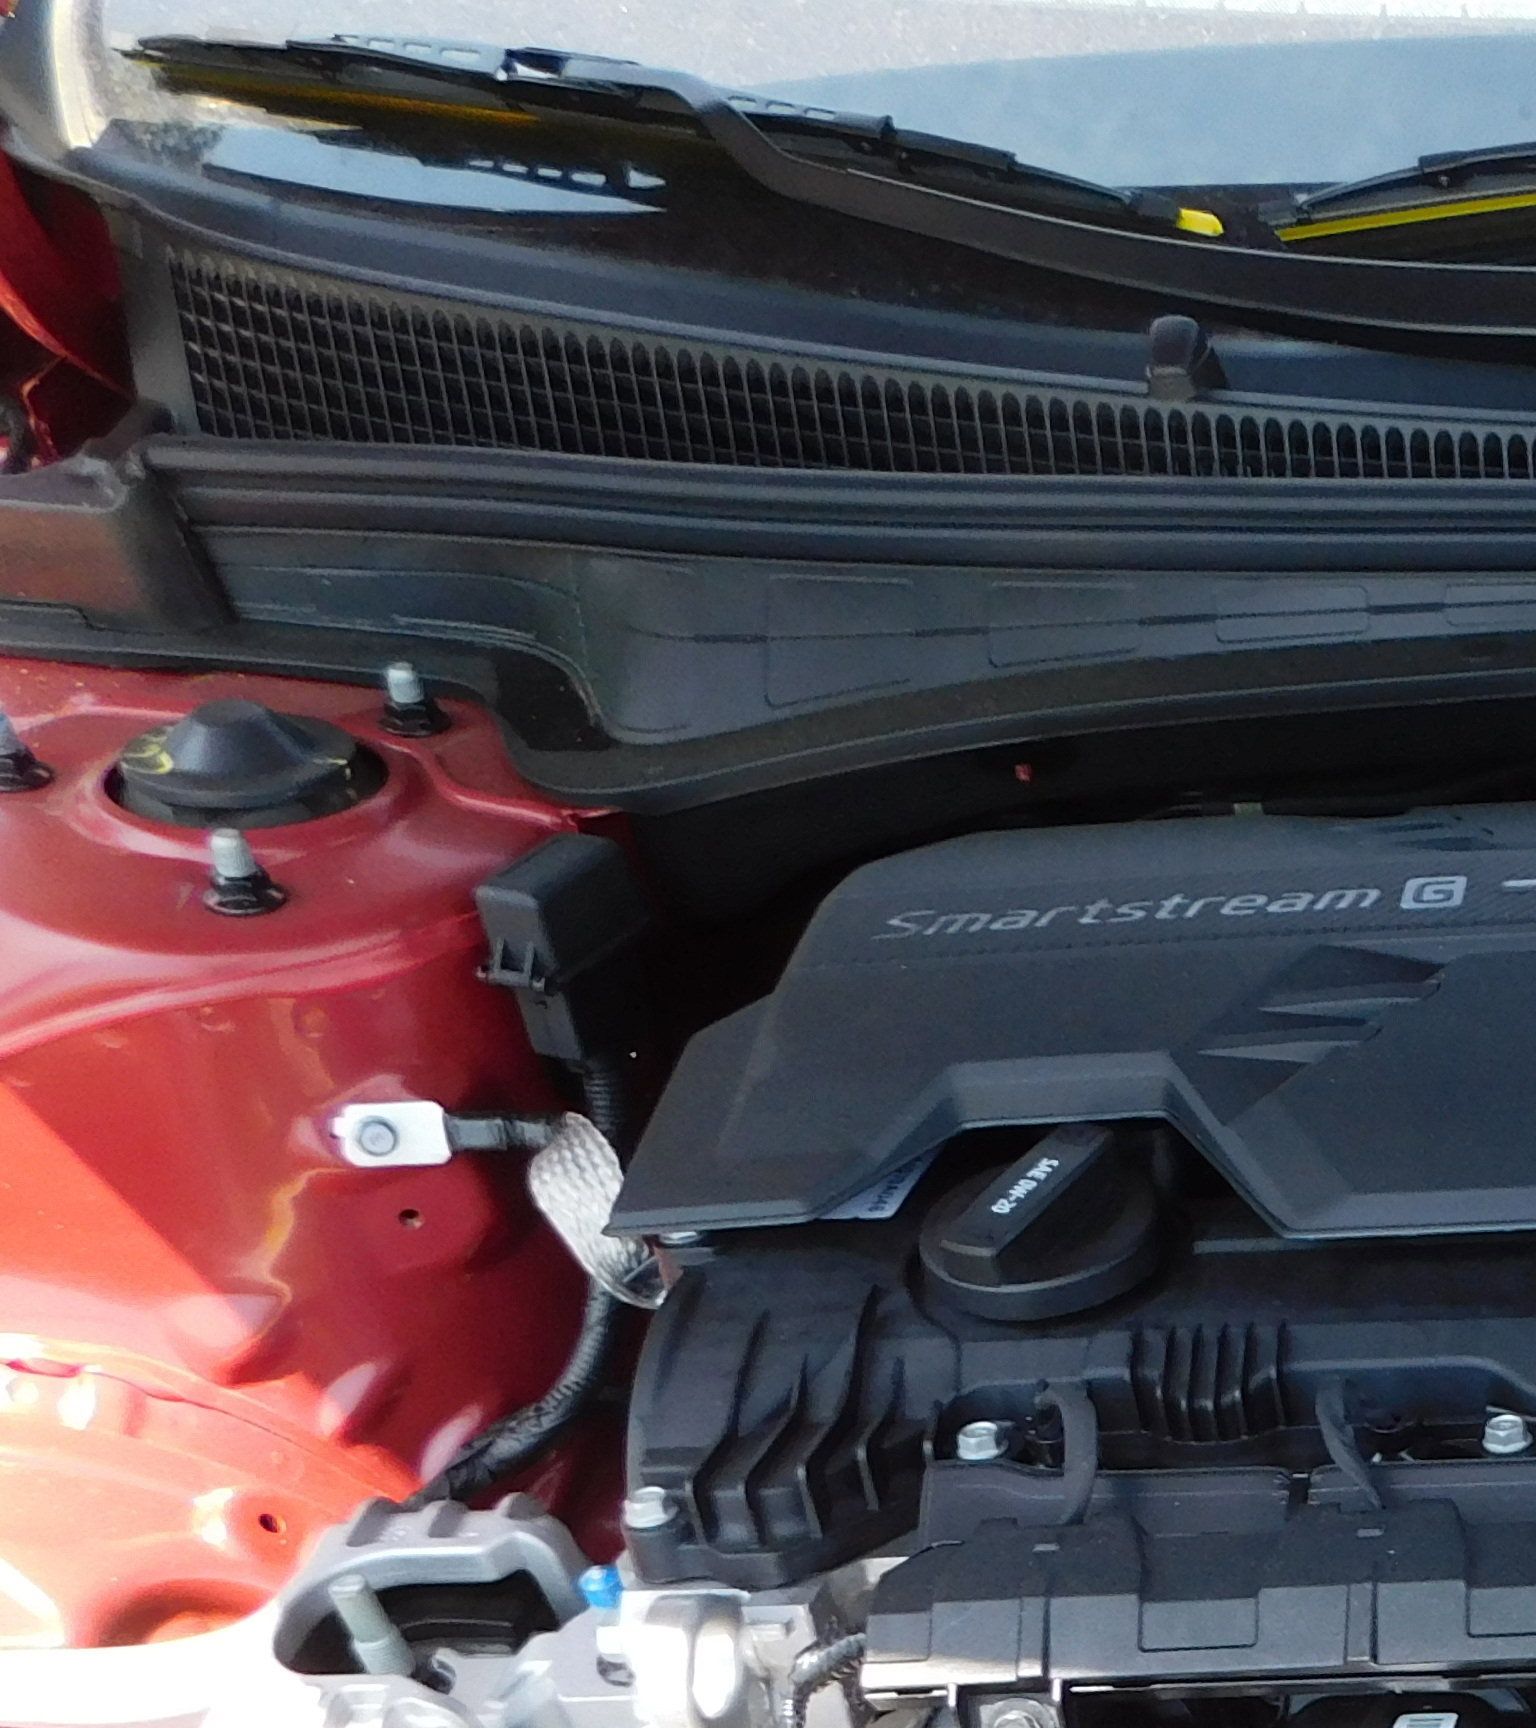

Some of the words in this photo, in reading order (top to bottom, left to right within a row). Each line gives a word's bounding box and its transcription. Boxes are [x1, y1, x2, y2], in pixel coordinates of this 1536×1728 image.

[871, 885, 1382, 940] Smartstream
[1401, 876, 1467, 909] G
[1030, 1157, 1060, 1182] SAE
[991, 1177, 1036, 1214] 0W-20
